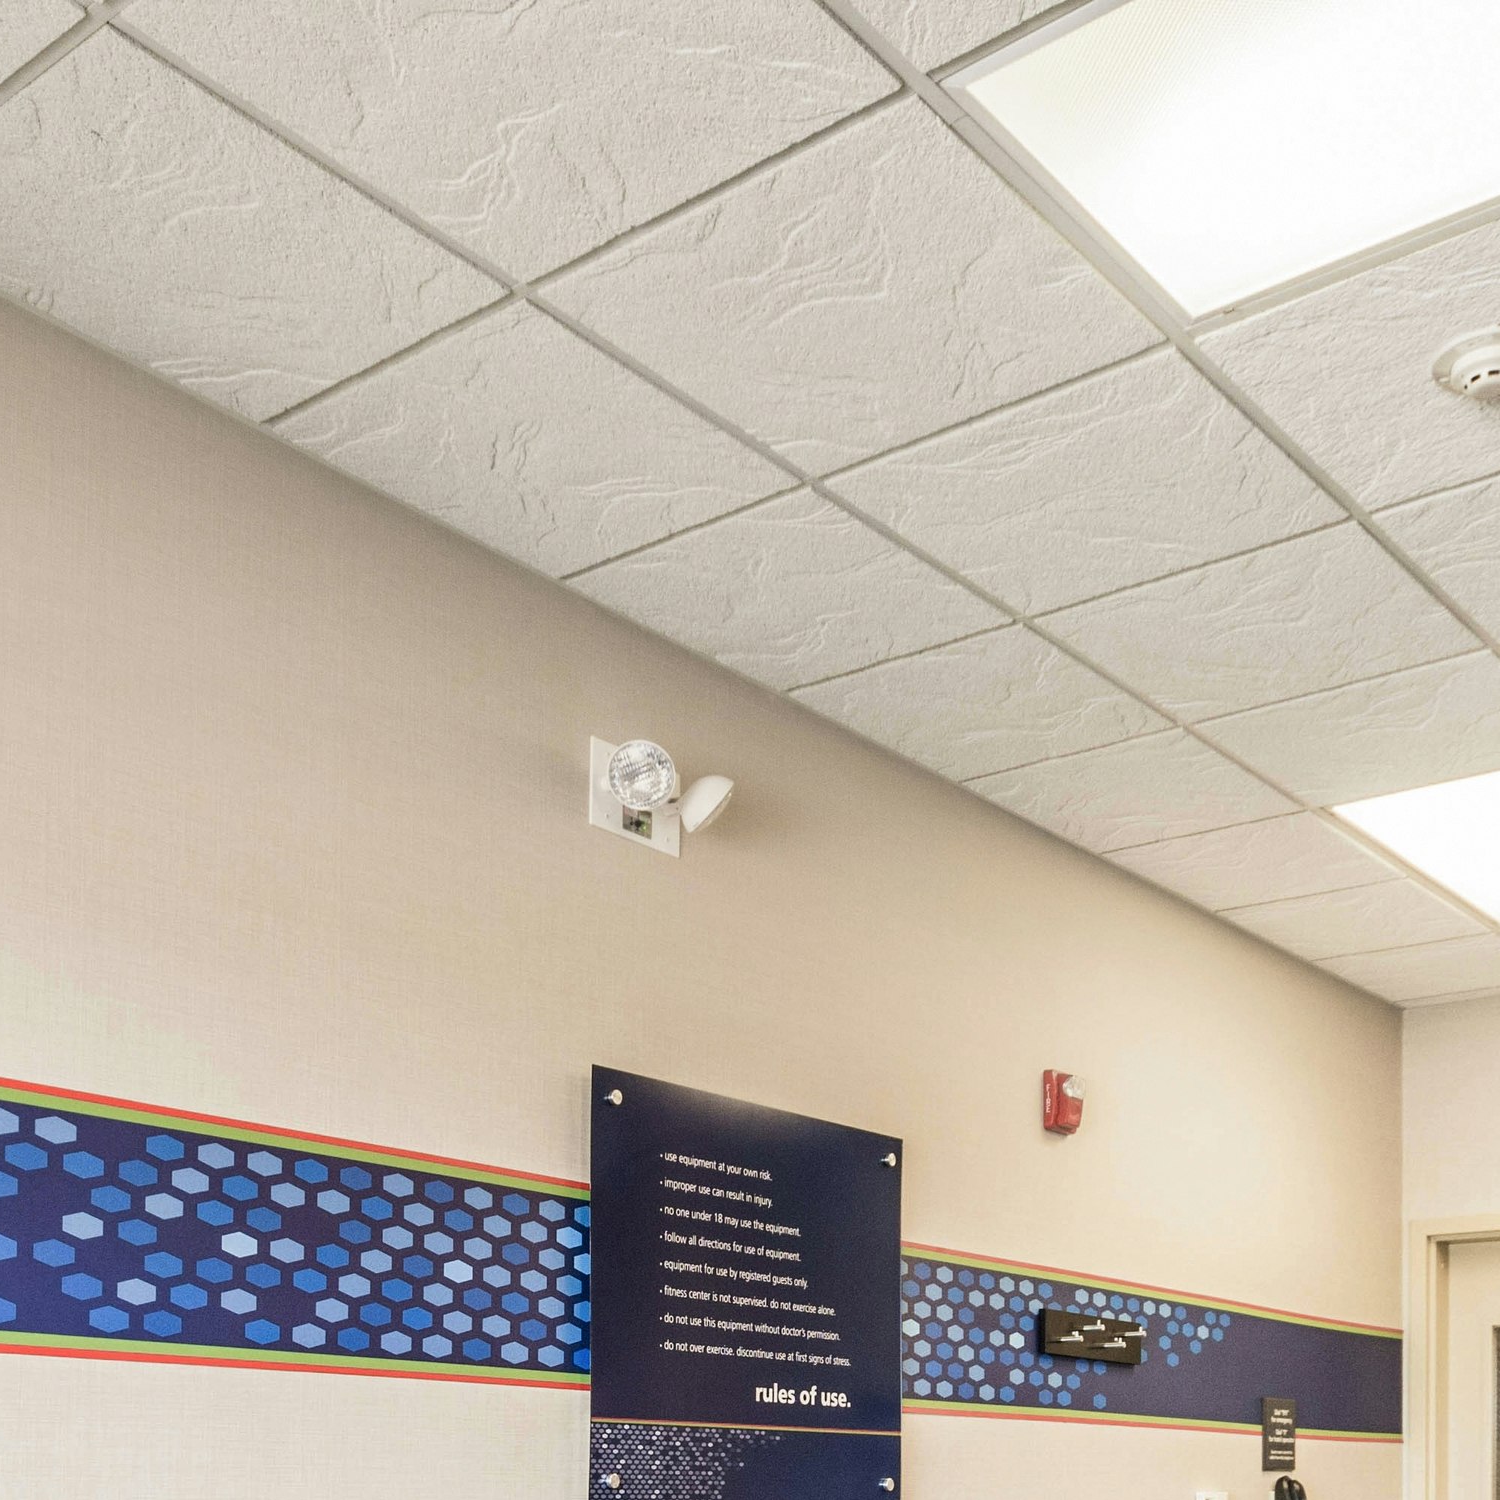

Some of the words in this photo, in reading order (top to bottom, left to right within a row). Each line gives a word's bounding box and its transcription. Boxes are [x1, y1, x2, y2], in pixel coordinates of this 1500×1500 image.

[664, 1152, 677, 1162] use
[679, 1155, 716, 1170] equipment
[718, 1162, 726, 1172] at
[726, 1164, 741, 1175] your
[744, 1169, 758, 1178] own
[760, 1169, 772, 1181] risk.
[664, 1177, 696, 1193] improper
[698, 1184, 710, 1195] use
[712, 1188, 724, 1198] can
[726, 1190, 744, 1202] result
[746, 1192, 752, 1202] in
[754, 1194, 773, 1208] injury.
[664, 1206, 674, 1216] no
[676, 1208, 690, 1218] one
[692, 1210, 712, 1221] under
[714, 1213, 723, 1224] 18
[724, 1216, 738, 1228] may
[740, 1220, 752, 1228] use
[754, 1220, 764, 1230] the
[766, 1223, 801, 1236] equipment.
[664, 1230, 686, 1244] follow
[688, 1234, 696, 1246] all
[698, 1236, 732, 1252] directions
[733, 1242, 742, 1252] for
[744, 1245, 756, 1255] use
[757, 1246, 764, 1256] of
[766, 1250, 801, 1262] equipment.
[664, 1260, 702, 1274] equipment
[704, 1262, 714, 1275] for
[716, 1266, 728, 1276] use
[730, 1267, 738, 1280] by
[739, 1270, 771, 1282] registered
[772, 1275, 792, 1286] guests
[794, 1276, 808, 1290] only.
[664, 1284, 687, 1298] fitness
[689, 1289, 710, 1300] center
[712, 1290, 718, 1302] is
[720, 1292, 731, 1303] not
[732, 1296, 768, 1308] supervised.
[770, 1299, 779, 1309] do
[780, 1301, 791, 1310] not
[792, 1302, 816, 1314] exercise
[818, 1304, 836, 1316] alone.
[664, 1312, 674, 1324] do
[676, 1314, 688, 1326] not
[690, 1317, 702, 1326] use
[704, 1316, 716, 1328] this
[718, 1320, 754, 1333] equipment
[755, 1322, 780, 1334] without
[782, 1325, 806, 1338] doctor's
[807, 1329, 841, 1342] permission.
[664, 1340, 674, 1350] do
[676, 1342, 688, 1352] not
[690, 1344, 704, 1353] over
[706, 1344, 734, 1356] exercise.
[736, 1346, 774, 1360] discontinue
[775, 1351, 786, 1360] use
[788, 1352, 794, 1362] at
[796, 1352, 807, 1363] first
[808, 1354, 824, 1365] signs
[825, 1354, 832, 1364] of
[833, 1356, 851, 1366] stress.
[755, 1382, 795, 1404] rules
[800, 1385, 817, 1405] of
[821, 1391, 851, 1408] use.
